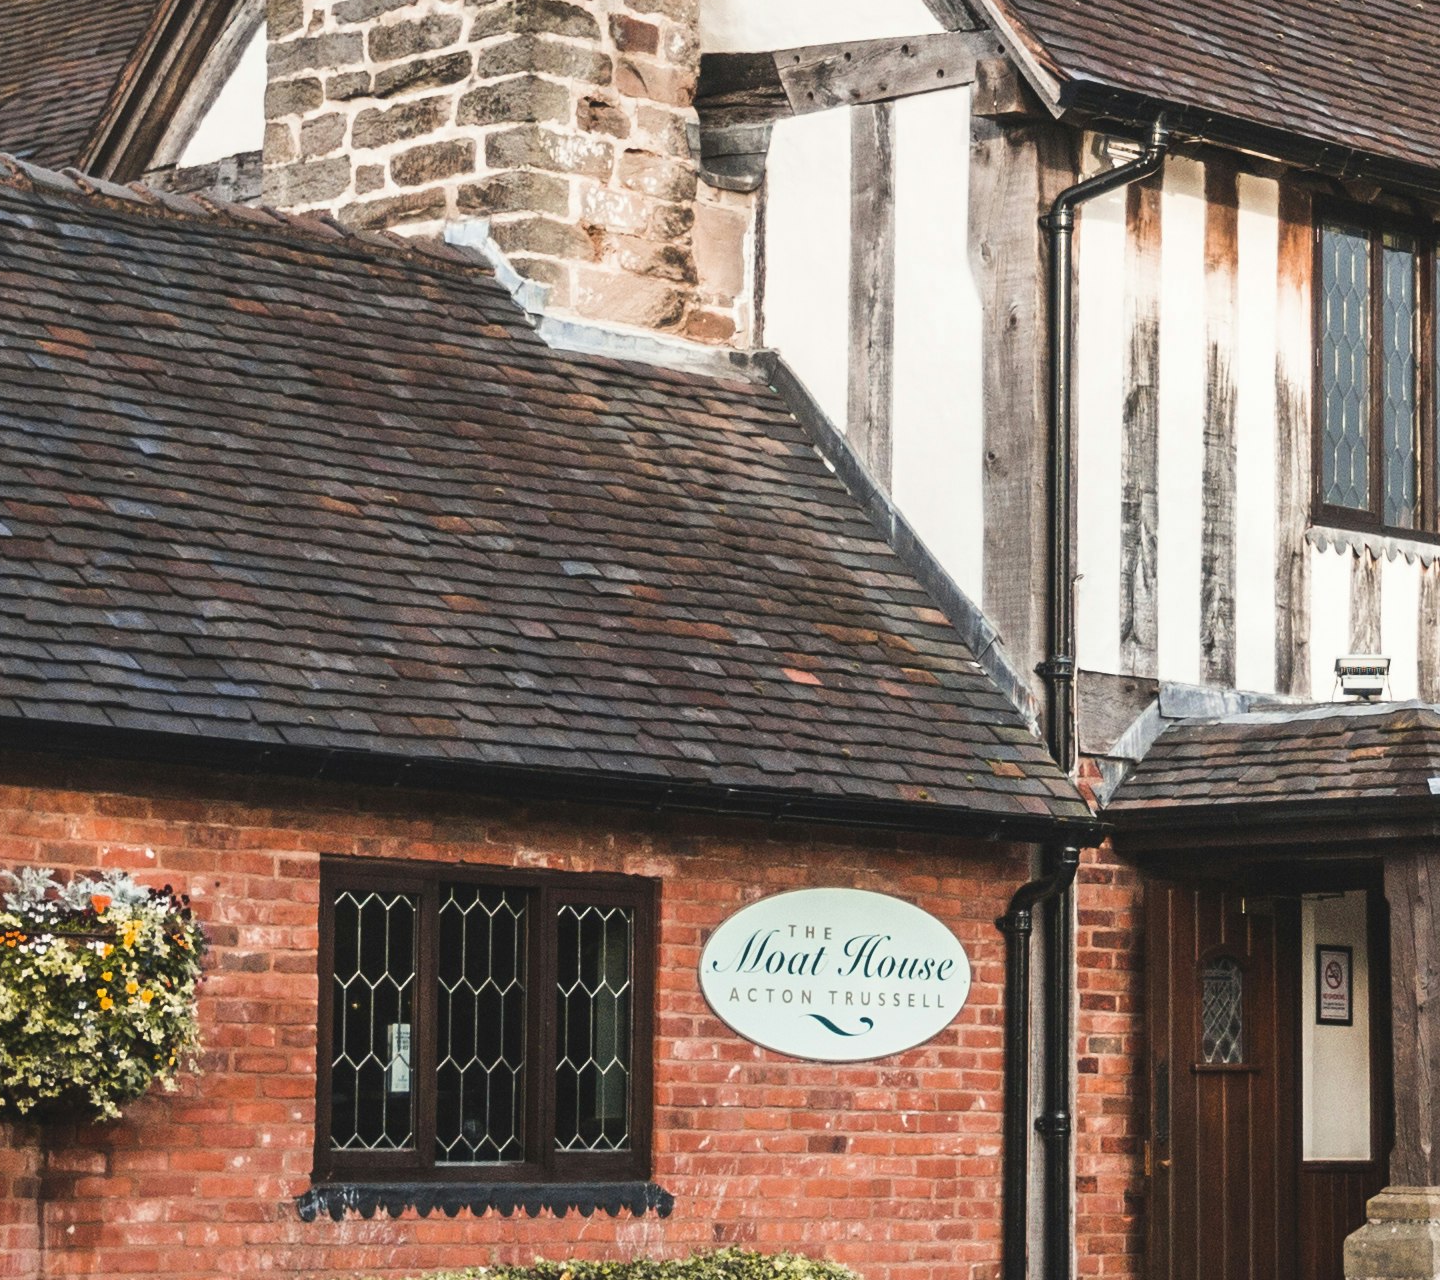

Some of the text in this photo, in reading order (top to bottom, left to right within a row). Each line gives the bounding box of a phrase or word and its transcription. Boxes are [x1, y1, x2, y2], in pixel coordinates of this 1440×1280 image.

[788, 924, 833, 940] THE
[712, 927, 956, 982] Moat House
[728, 986, 945, 1009] ACTON TRUSSELL
